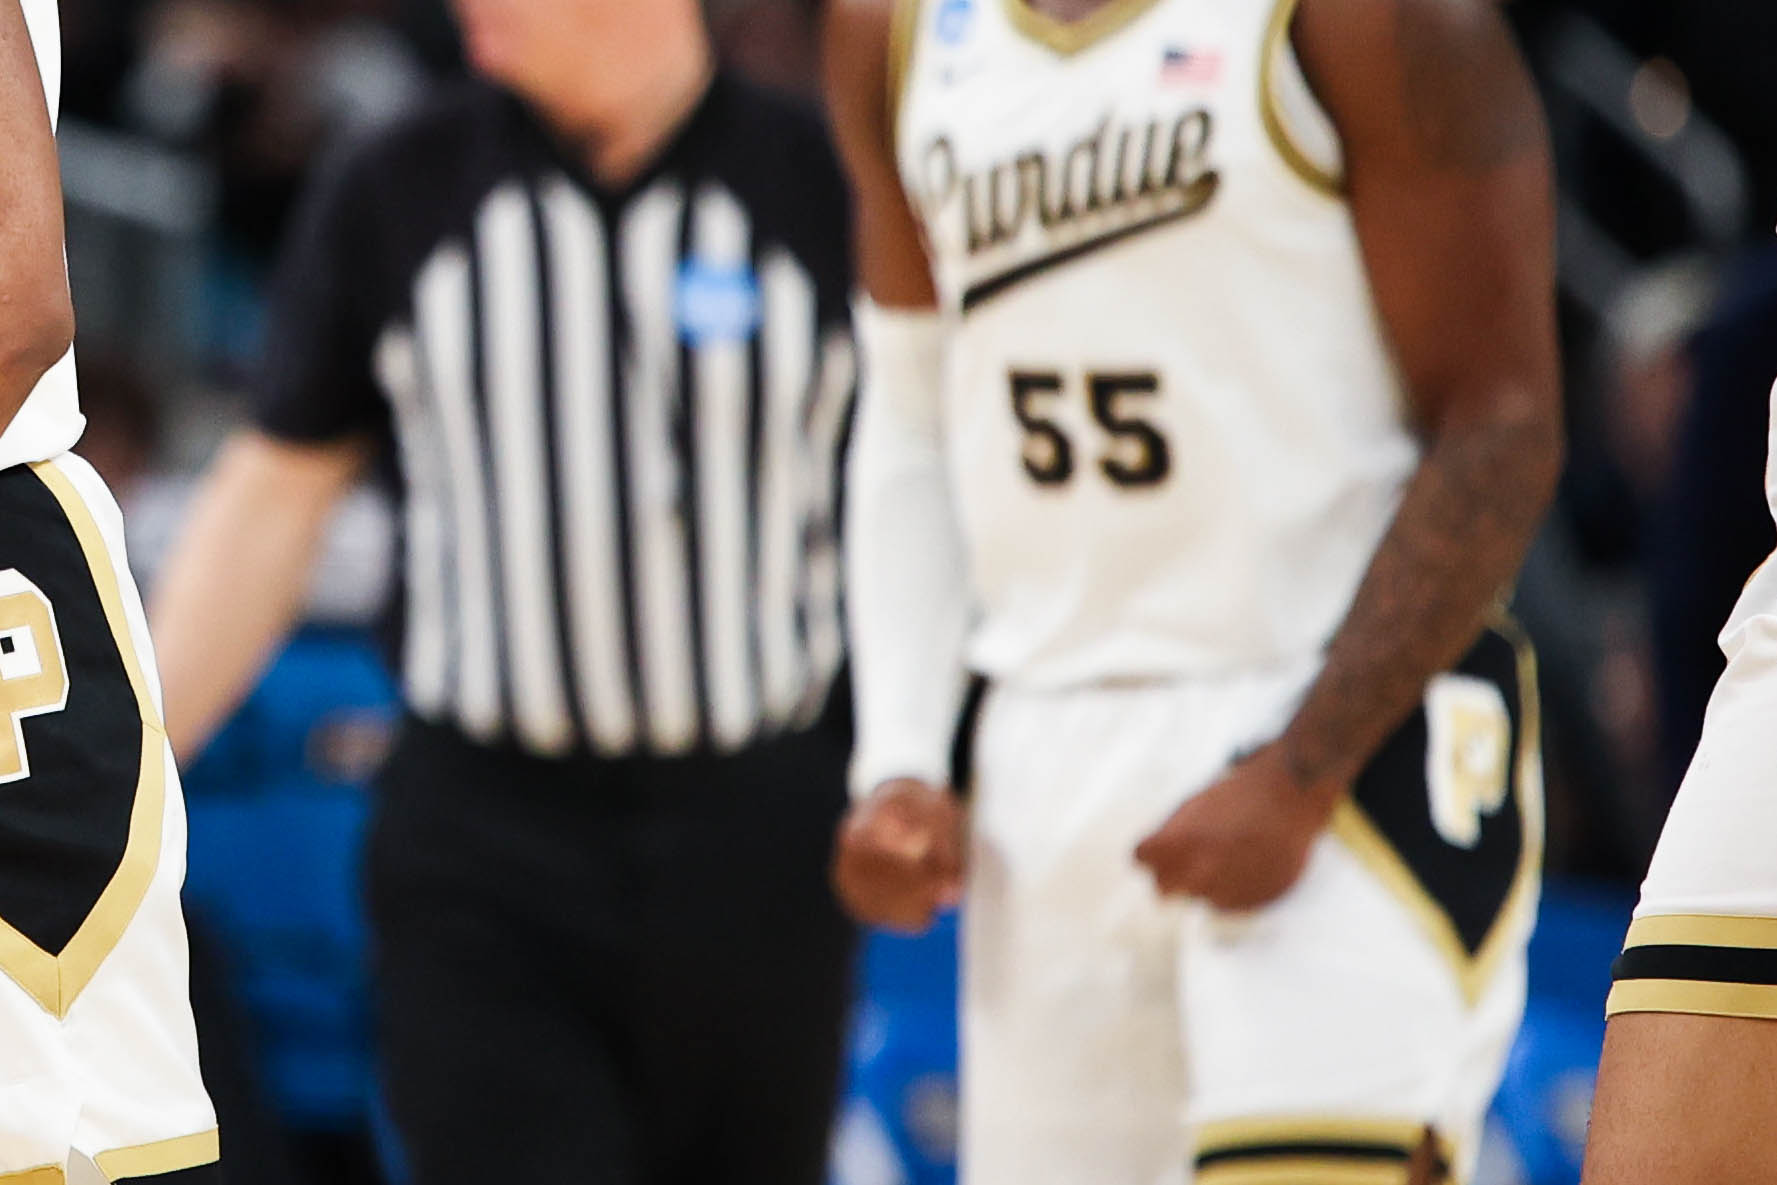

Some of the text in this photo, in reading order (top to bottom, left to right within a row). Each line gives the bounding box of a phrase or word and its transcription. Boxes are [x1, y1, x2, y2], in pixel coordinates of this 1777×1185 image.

[923, 108, 1220, 262] Purdue
[1008, 366, 1174, 490] 55
[1424, 672, 1511, 850] P
